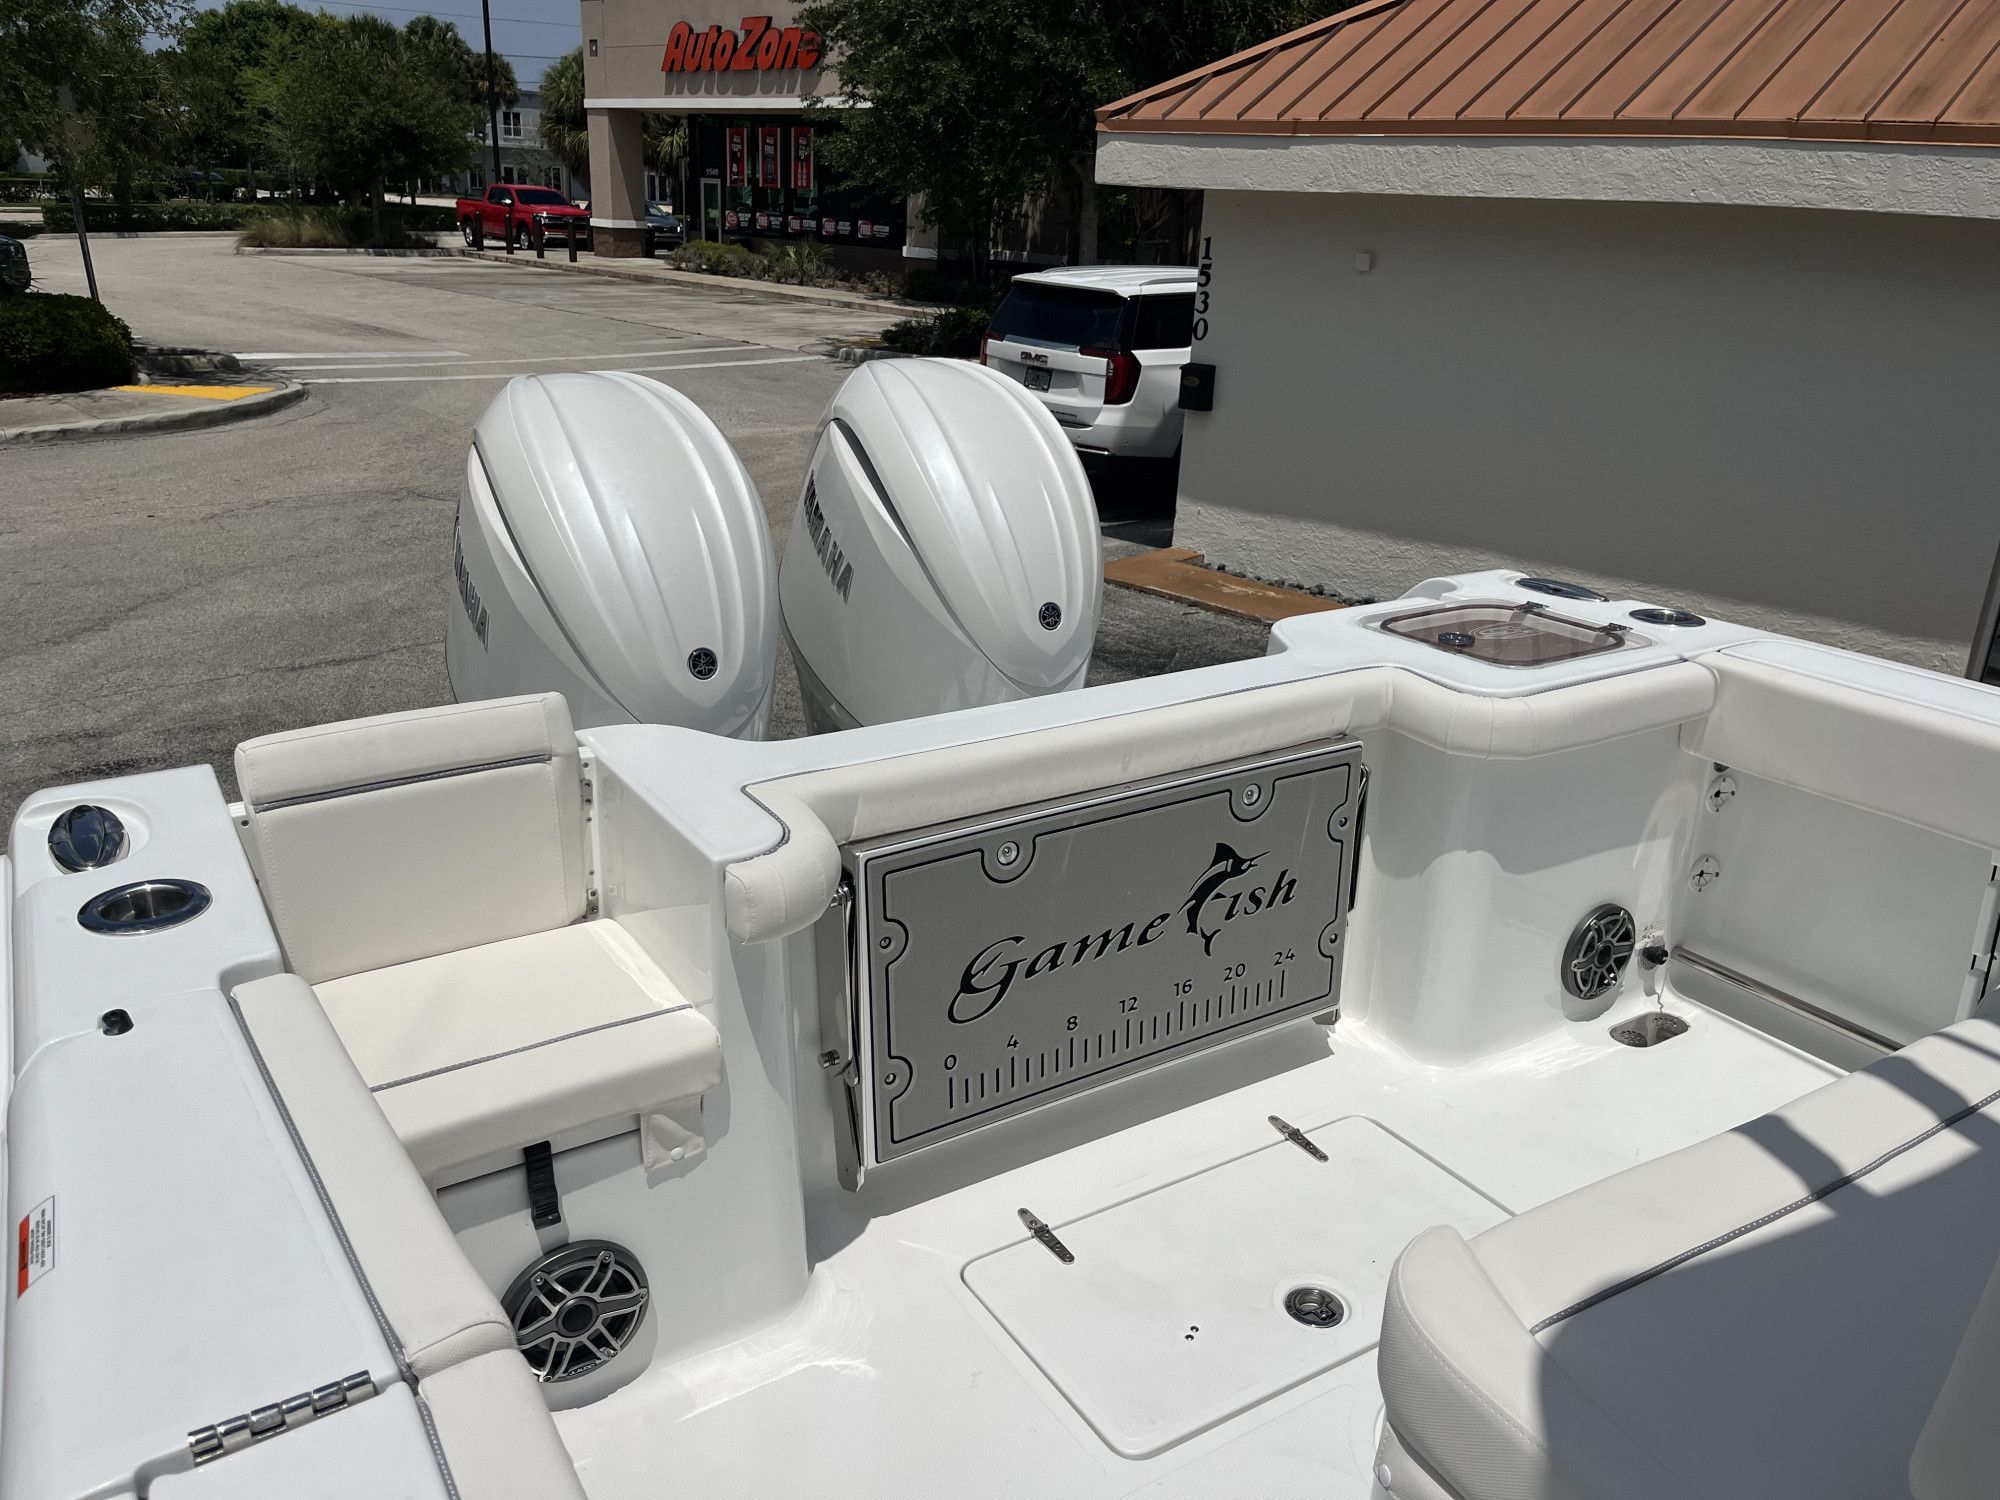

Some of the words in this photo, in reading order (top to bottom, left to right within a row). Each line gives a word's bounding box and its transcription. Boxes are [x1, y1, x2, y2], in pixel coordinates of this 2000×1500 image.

[661, 15, 823, 73] AutoZone
[1192, 236, 1213, 342] 1530
[1020, 351, 1049, 365] GMC
[804, 469, 855, 607] YAMAHA
[943, 1054, 958, 1071] 0
[1006, 1034, 1020, 1049] 4
[1066, 1015, 1079, 1031] 8
[1119, 996, 1139, 1014] 12
[1173, 979, 1194, 998] 16
[1223, 962, 1247, 982] 20
[1273, 948, 1296, 967] 24
